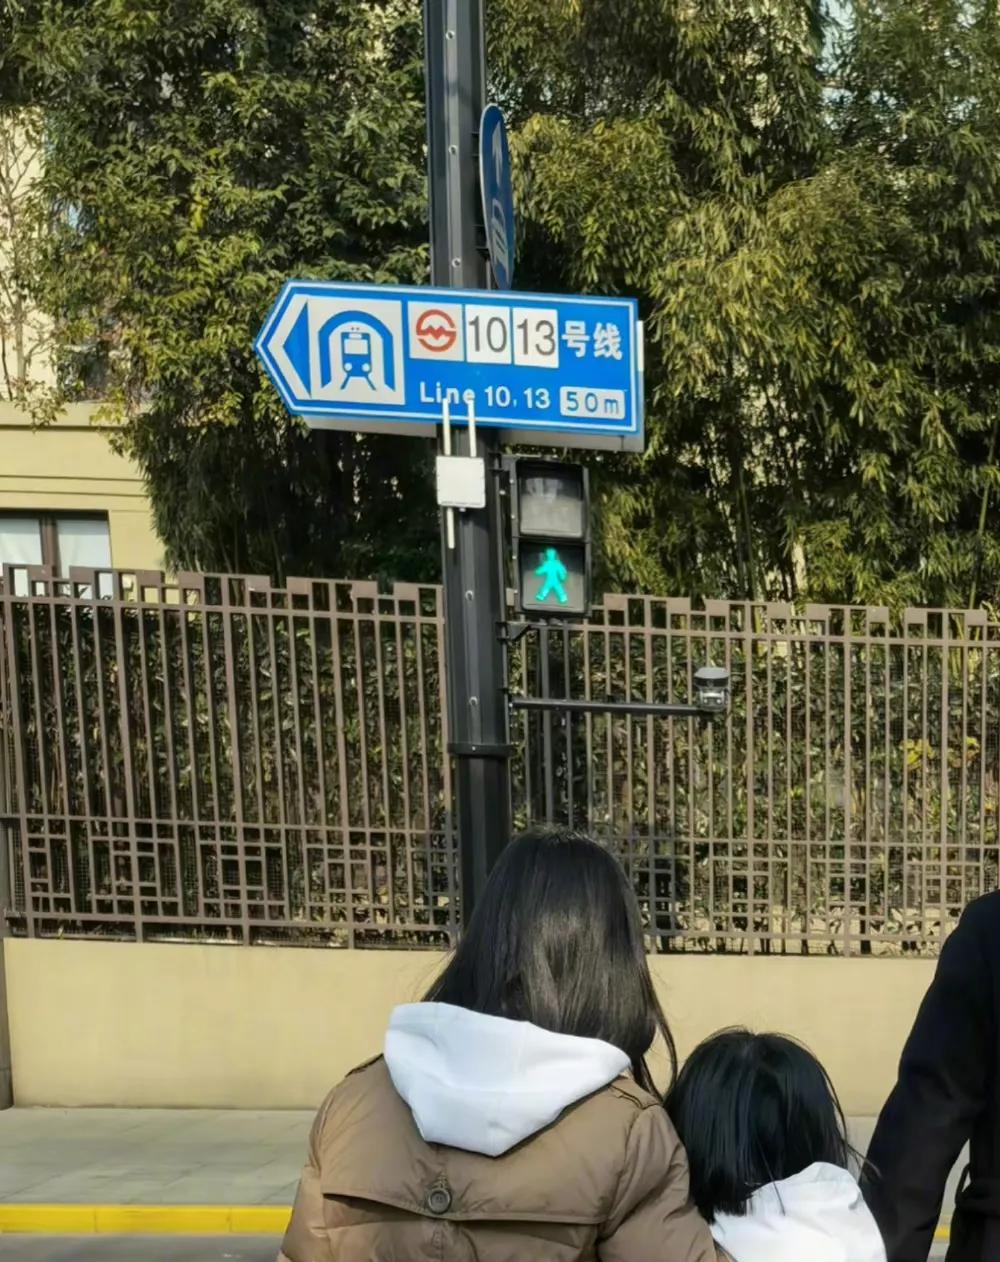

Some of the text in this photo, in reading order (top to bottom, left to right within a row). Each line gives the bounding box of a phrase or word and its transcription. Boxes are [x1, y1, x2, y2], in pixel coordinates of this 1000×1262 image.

[468, 315, 623, 360] 10 13 号线
[419, 380, 476, 405] Line
[523, 387, 551, 409] 13
[565, 390, 620, 415] 50m
